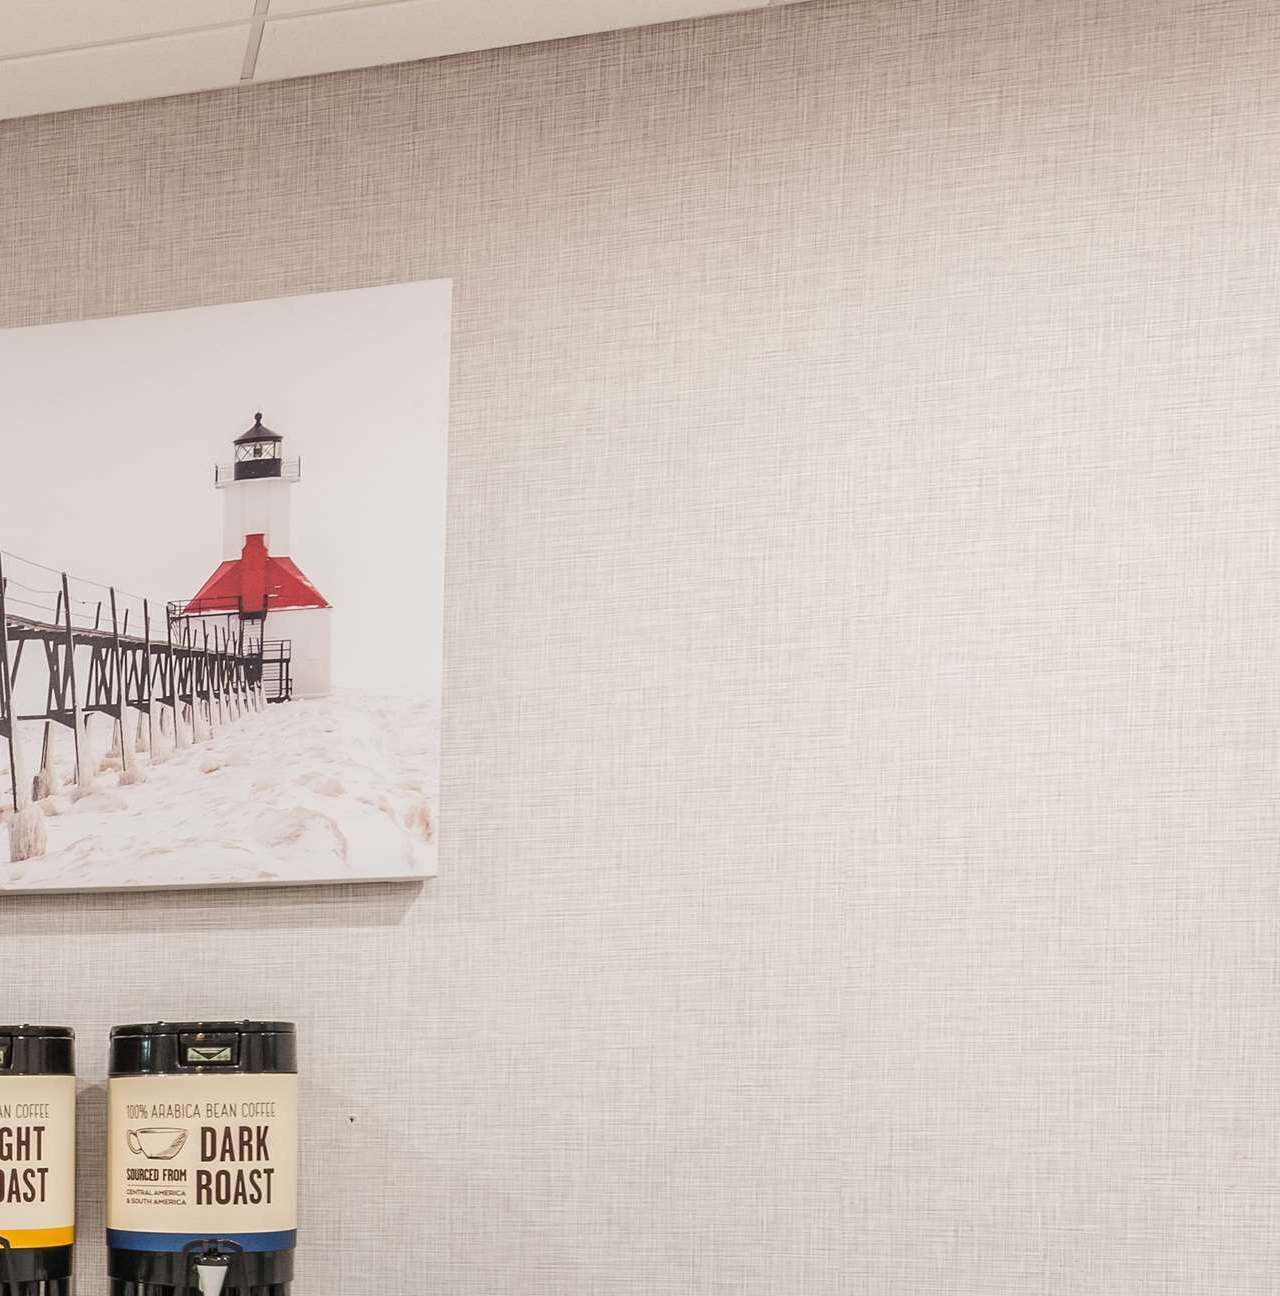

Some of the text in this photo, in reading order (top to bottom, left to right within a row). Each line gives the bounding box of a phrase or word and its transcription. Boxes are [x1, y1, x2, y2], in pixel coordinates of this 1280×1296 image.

[16, 1104, 49, 1118] COFFEE
[127, 1102, 275, 1119] 100% ARABICA BEAN COFFEE
[201, 1126, 269, 1162] DARK
[127, 1169, 187, 1181] SOURCED FROM
[196, 1168, 275, 1205] ROAST
